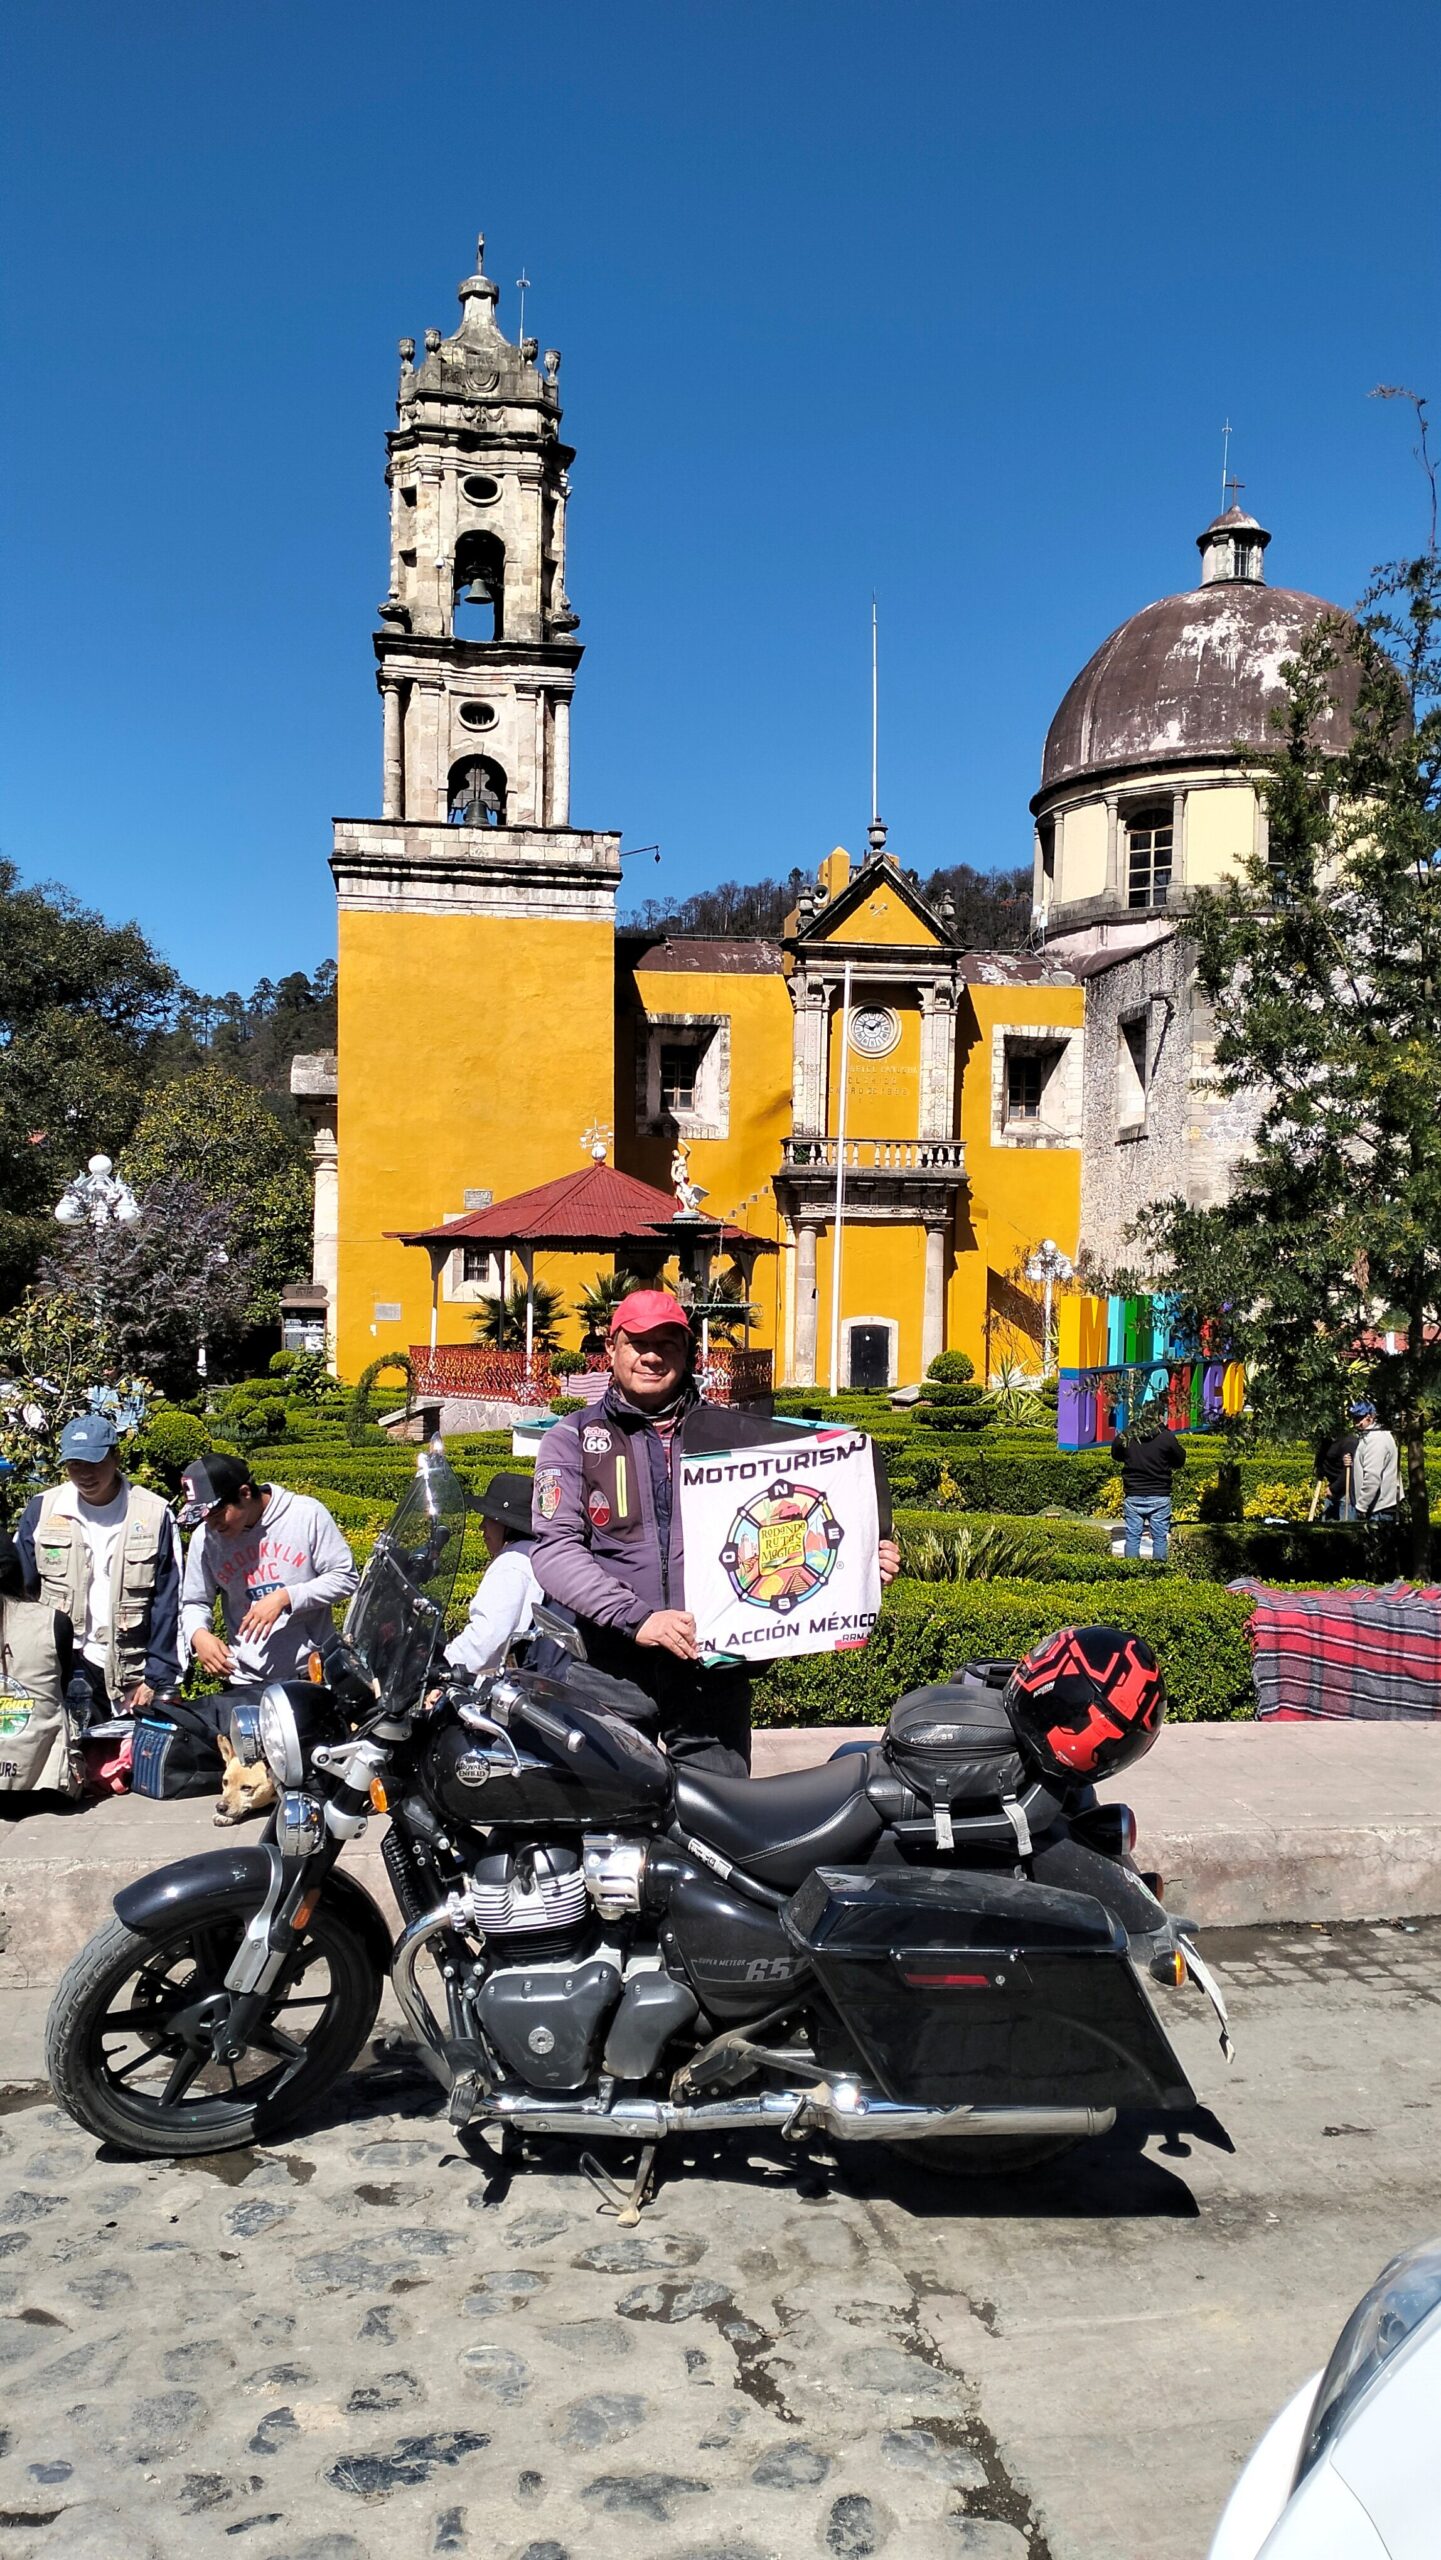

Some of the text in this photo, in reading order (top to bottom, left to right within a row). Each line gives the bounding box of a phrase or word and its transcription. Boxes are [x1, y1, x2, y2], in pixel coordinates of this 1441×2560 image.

[586, 1437, 608, 1451] 66
[774, 1484, 788, 1496] N
[828, 1528, 840, 1540] E
[722, 1551, 736, 1563] O
[242, 1562, 280, 1585] NYC
[778, 1598, 791, 1610] S
[725, 1620, 800, 1648] ACCIÓN
[809, 1611, 877, 1634] MÉXICO
[719, 1959, 746, 1967] METEOR
